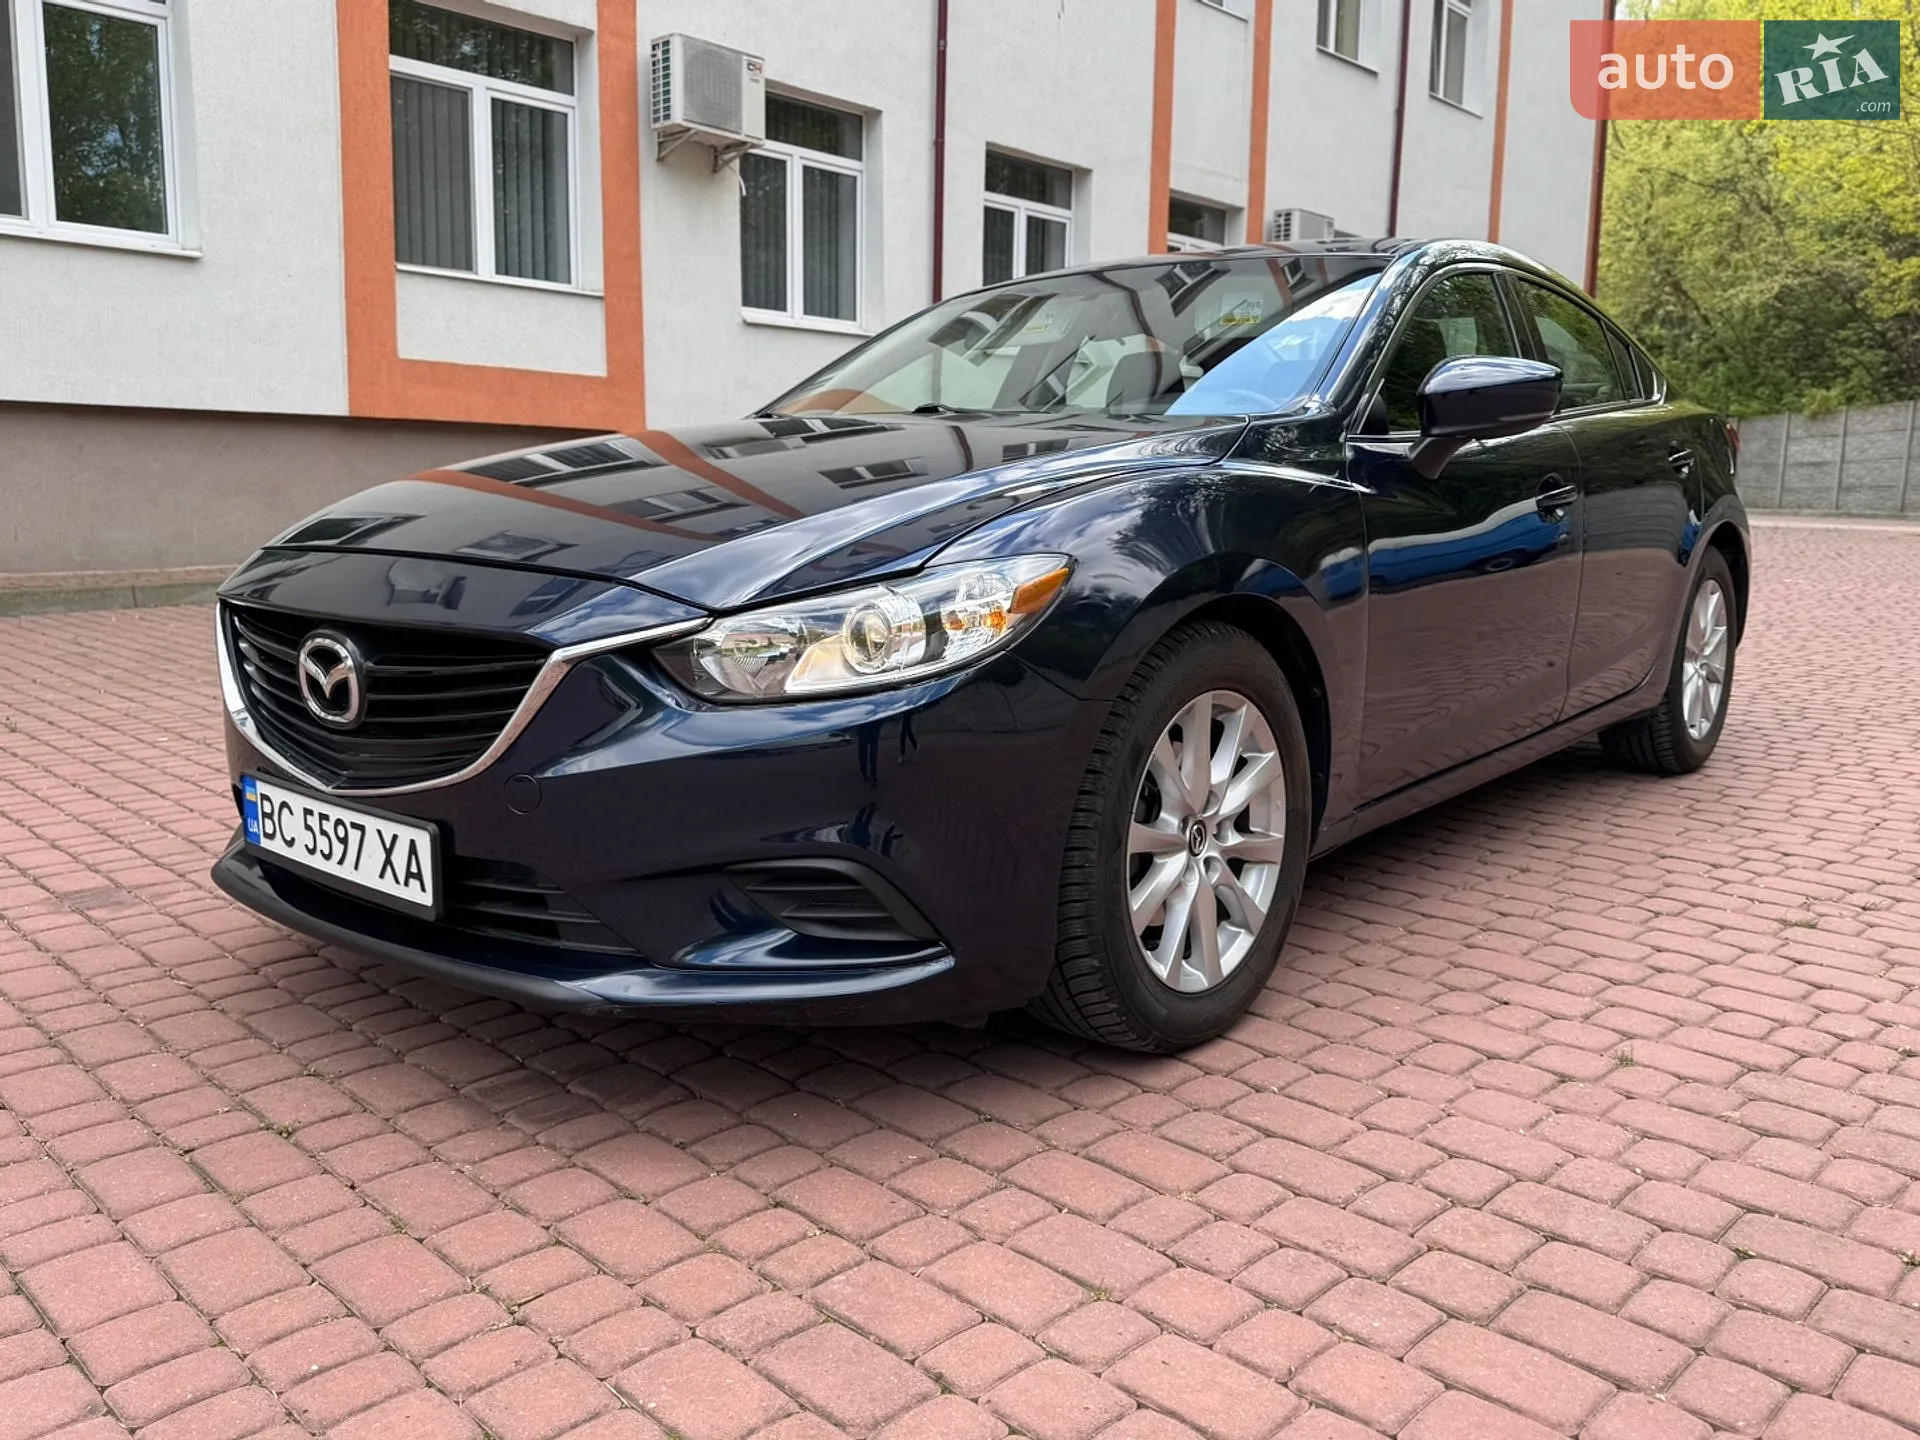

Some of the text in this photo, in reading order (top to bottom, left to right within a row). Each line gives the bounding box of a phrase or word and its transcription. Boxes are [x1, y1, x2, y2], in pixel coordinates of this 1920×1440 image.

[247, 817, 259, 835] UA
[260, 793, 427, 893] BC 5597 XA
